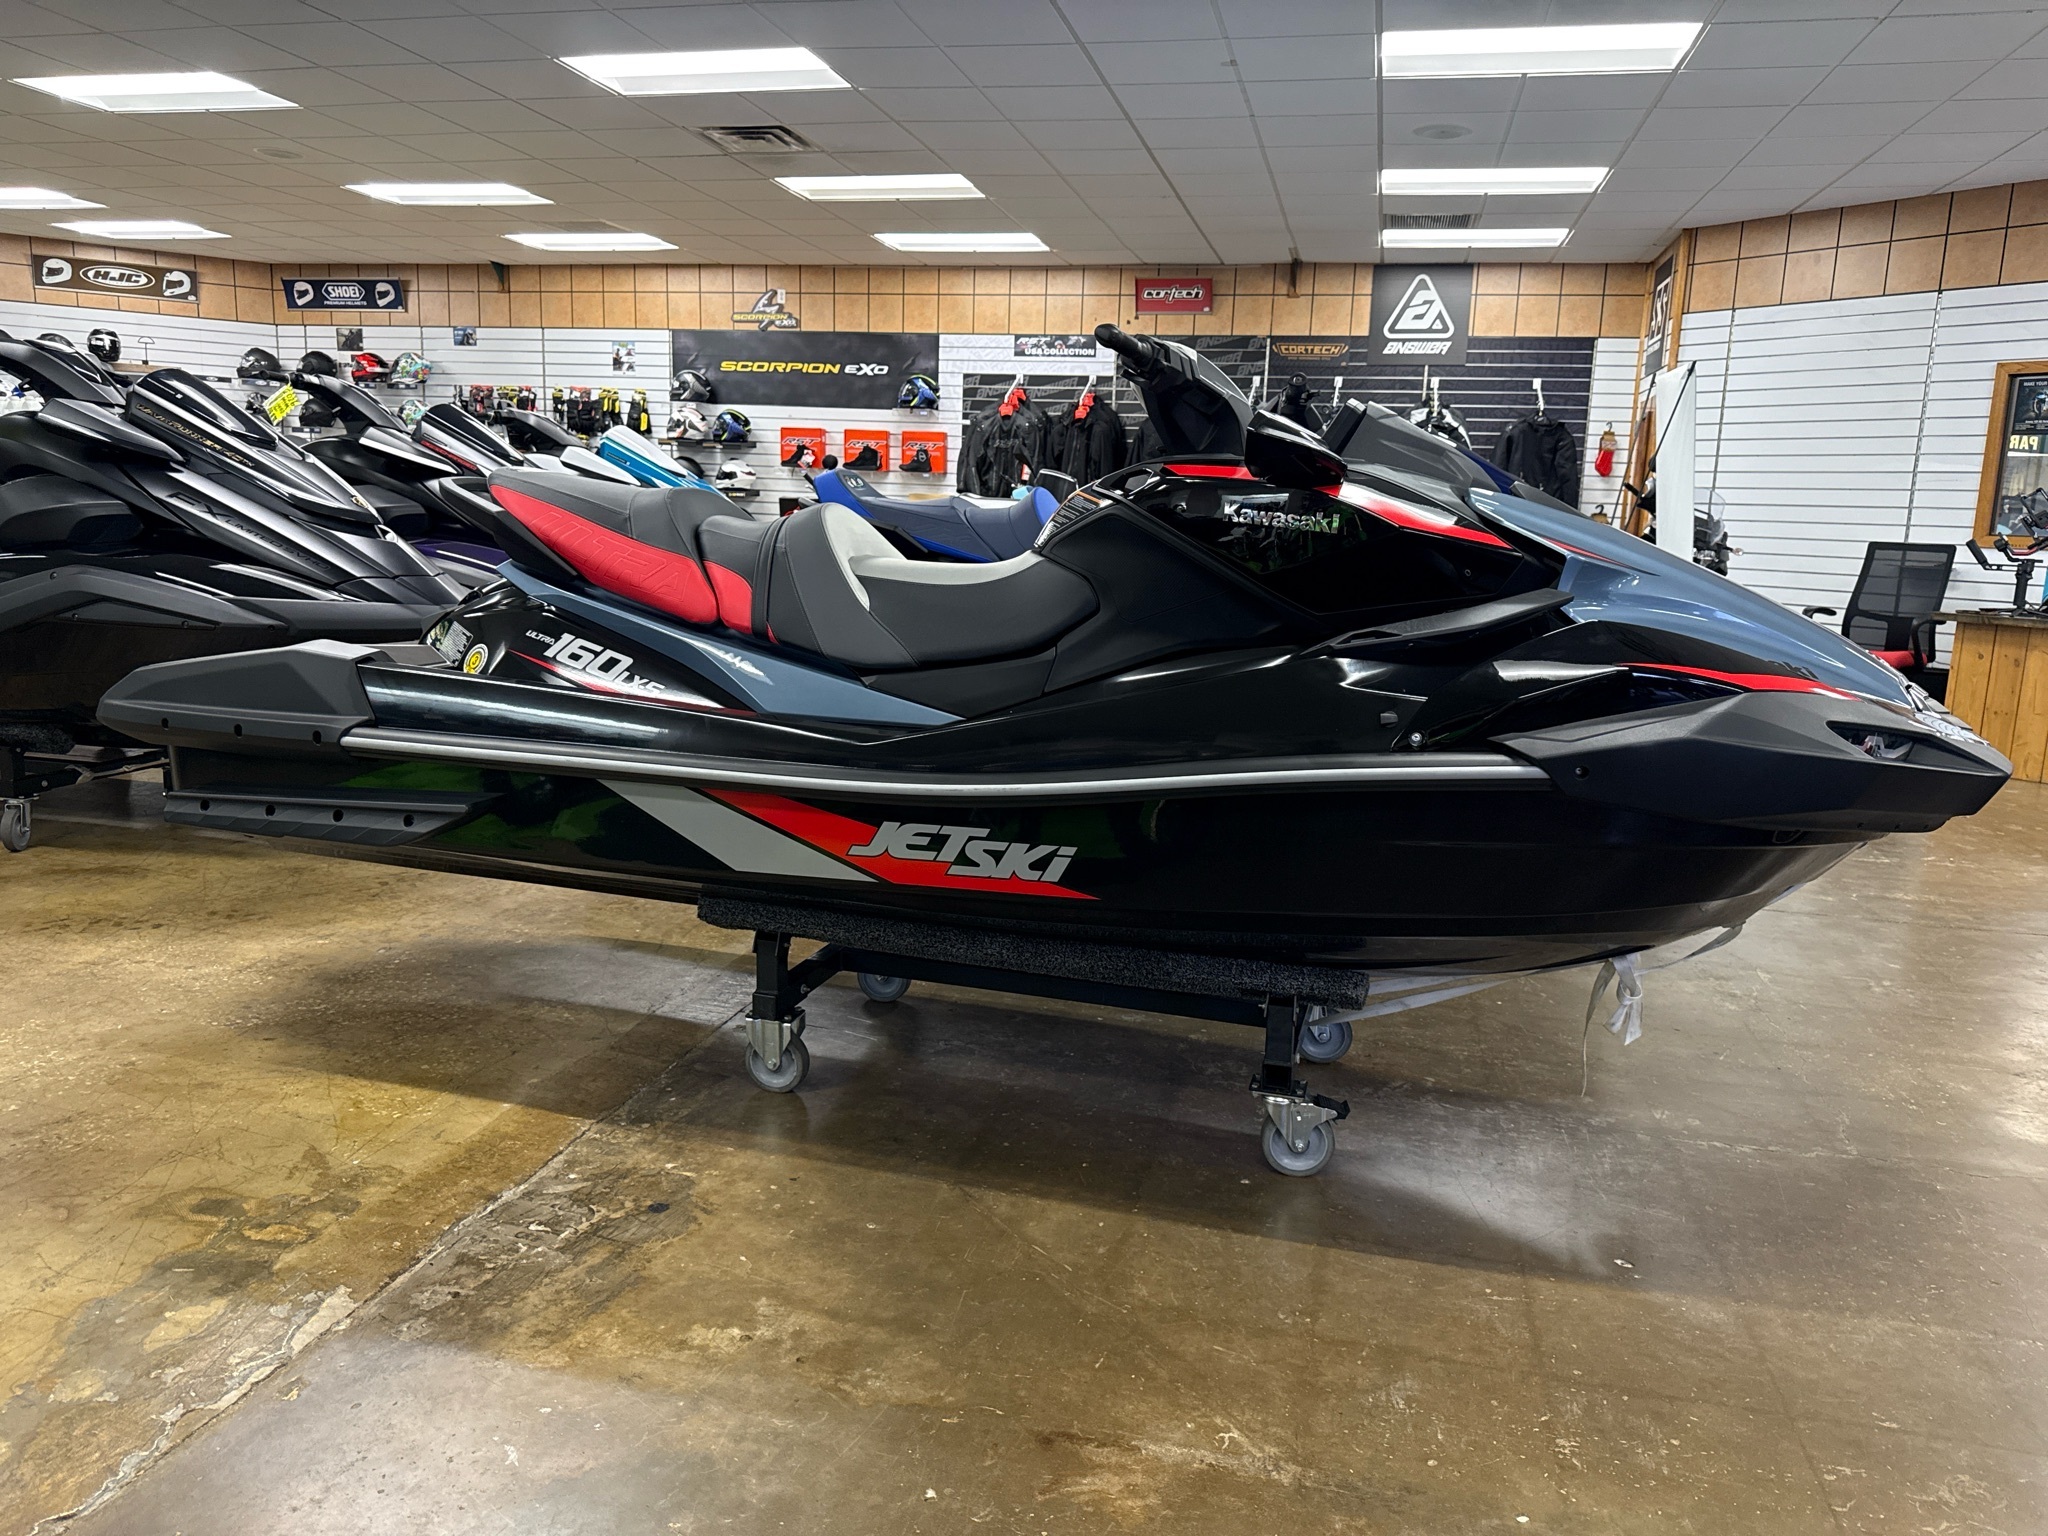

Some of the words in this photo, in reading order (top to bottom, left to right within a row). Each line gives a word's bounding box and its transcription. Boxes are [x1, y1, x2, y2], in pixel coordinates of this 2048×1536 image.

[92, 269, 143, 284] HJC
[327, 285, 360, 298] SHOEI
[1143, 286, 1203, 302] cortech
[732, 313, 789, 321] SCORPION
[1043, 348, 1095, 356] COLLECTION
[1280, 345, 1341, 354] CORTECH
[1382, 341, 1453, 355] ANSWER
[719, 361, 841, 374] SCORPION
[782, 437, 821, 446] RST
[846, 440, 887, 449] RST
[903, 441, 944, 450] RST
[166, 491, 236, 522] FX
[225, 518, 283, 548] LIMITED
[1222, 501, 1341, 535] Kawasaki
[525, 629, 556, 646] ULTRA
